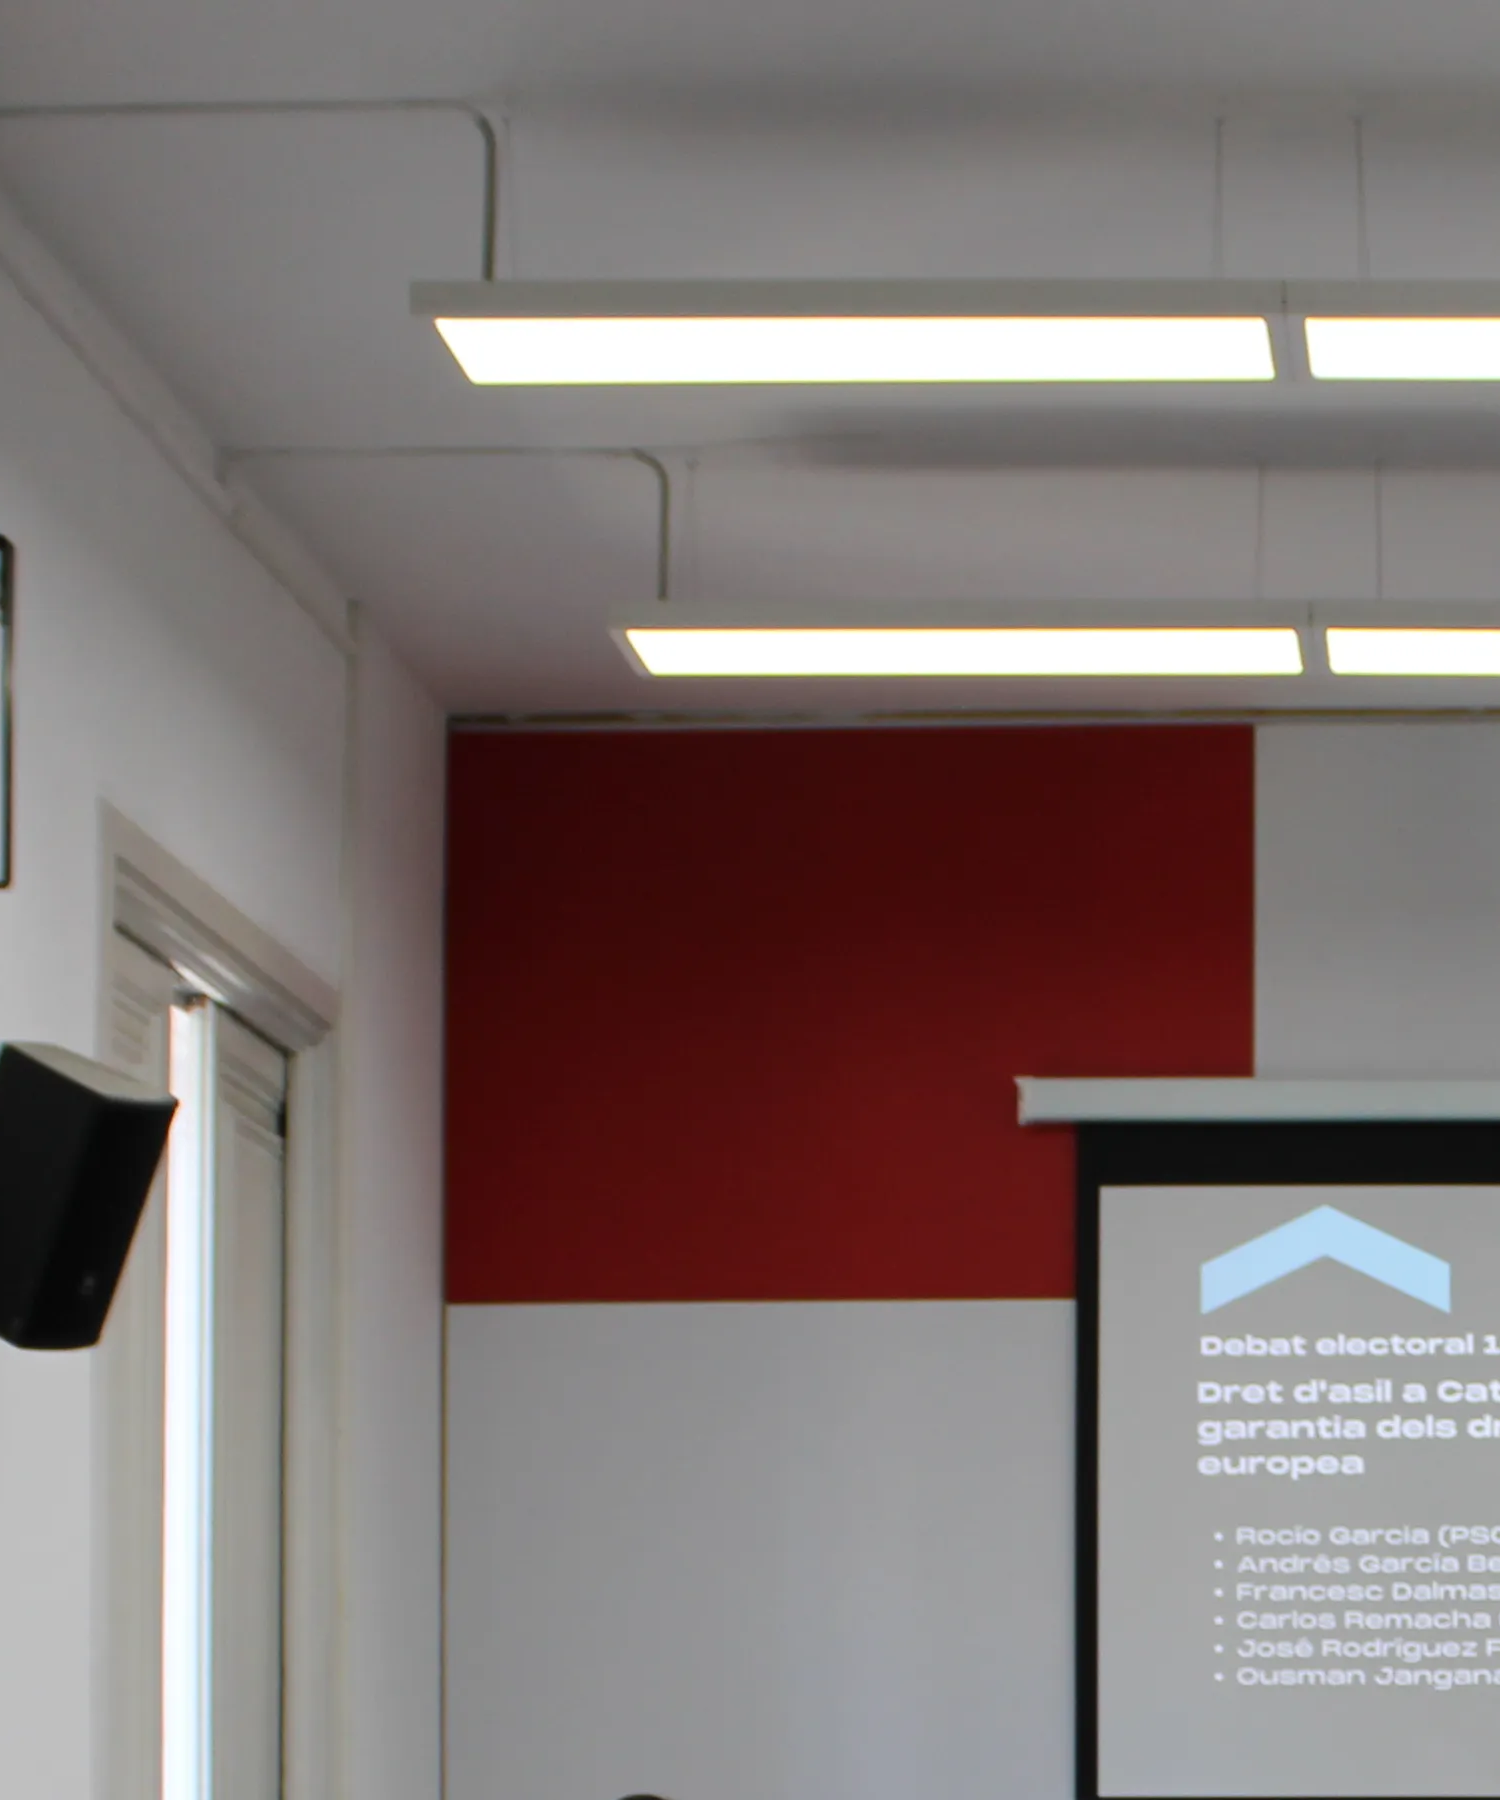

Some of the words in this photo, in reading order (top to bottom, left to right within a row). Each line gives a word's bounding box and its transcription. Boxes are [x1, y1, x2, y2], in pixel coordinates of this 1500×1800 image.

[1199, 1333, 1308, 1357] Debat
[1314, 1332, 1476, 1357] electoral
[1196, 1379, 1285, 1405] Dret
[1292, 1377, 1394, 1405] d'asil
[1401, 1382, 1428, 1404] a
[1196, 1413, 1368, 1447] garantia
[1375, 1413, 1459, 1440] dels
[1196, 1454, 1366, 1482] europea
[1236, 1553, 1352, 1575] Andrés
[1235, 1582, 1385, 1602] Francesc
[1235, 1609, 1337, 1630] Carlos
[1343, 1608, 1492, 1630] Remacha
[1236, 1636, 1315, 1658] José
[1320, 1636, 1479, 1663] Rodríguez
[1235, 1666, 1367, 1686] Ousman
